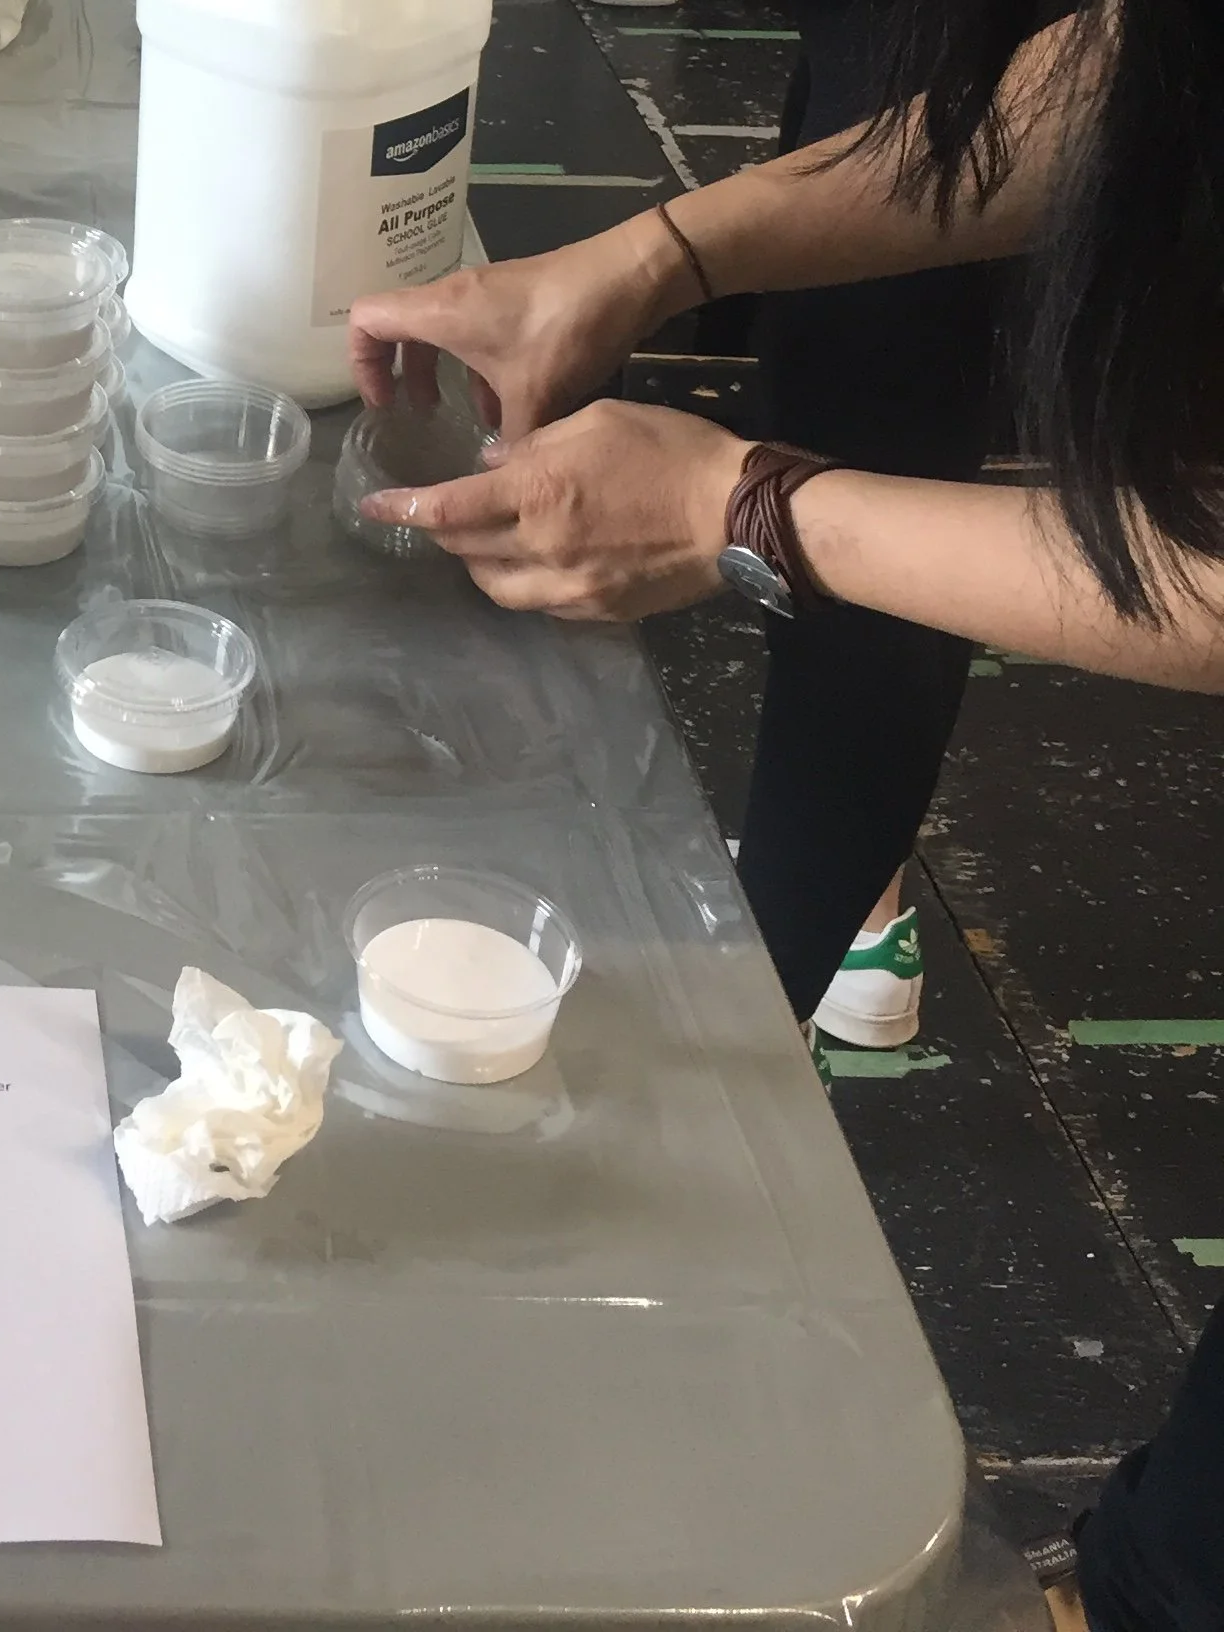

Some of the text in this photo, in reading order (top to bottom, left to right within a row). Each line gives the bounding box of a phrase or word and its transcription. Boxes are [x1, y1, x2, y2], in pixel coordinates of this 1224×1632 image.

[385, 119, 460, 160] amazonbasics
[378, 192, 455, 235] All Purpose
[381, 193, 425, 215] Washable
[386, 225, 425, 247] SCHOOL
[1024, 1538, 1070, 1561] SMANIA
[1029, 1548, 1078, 1571] STRALIA
